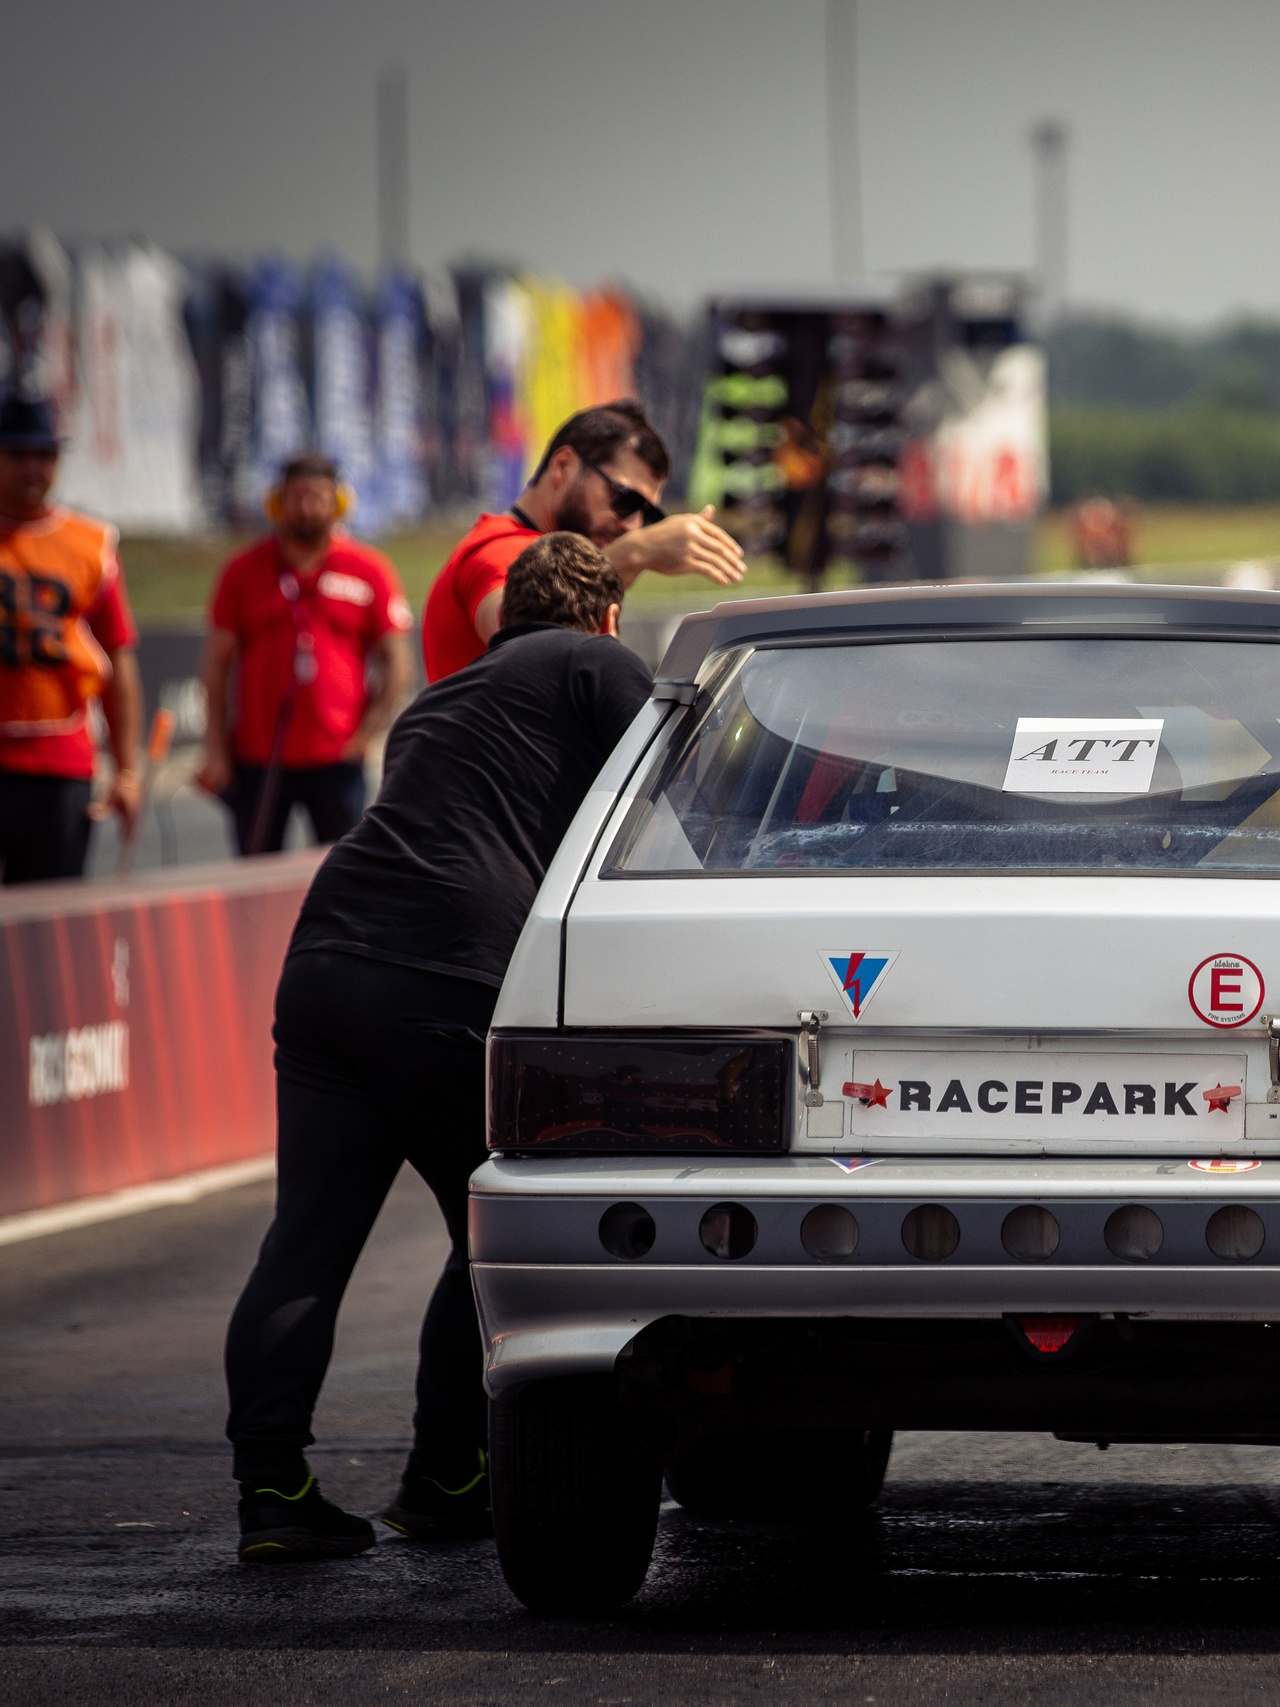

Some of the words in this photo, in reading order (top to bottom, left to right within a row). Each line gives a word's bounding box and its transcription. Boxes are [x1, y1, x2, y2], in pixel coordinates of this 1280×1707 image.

[1014, 738, 1156, 762] ATT
[1213, 960, 1241, 968] lifeline
[1210, 968, 1244, 1012] E
[1207, 1012, 1219, 1022] FIRE
[1220, 1012, 1246, 1023] SYSTEMS
[898, 1079, 1199, 1116] RACEPARK
